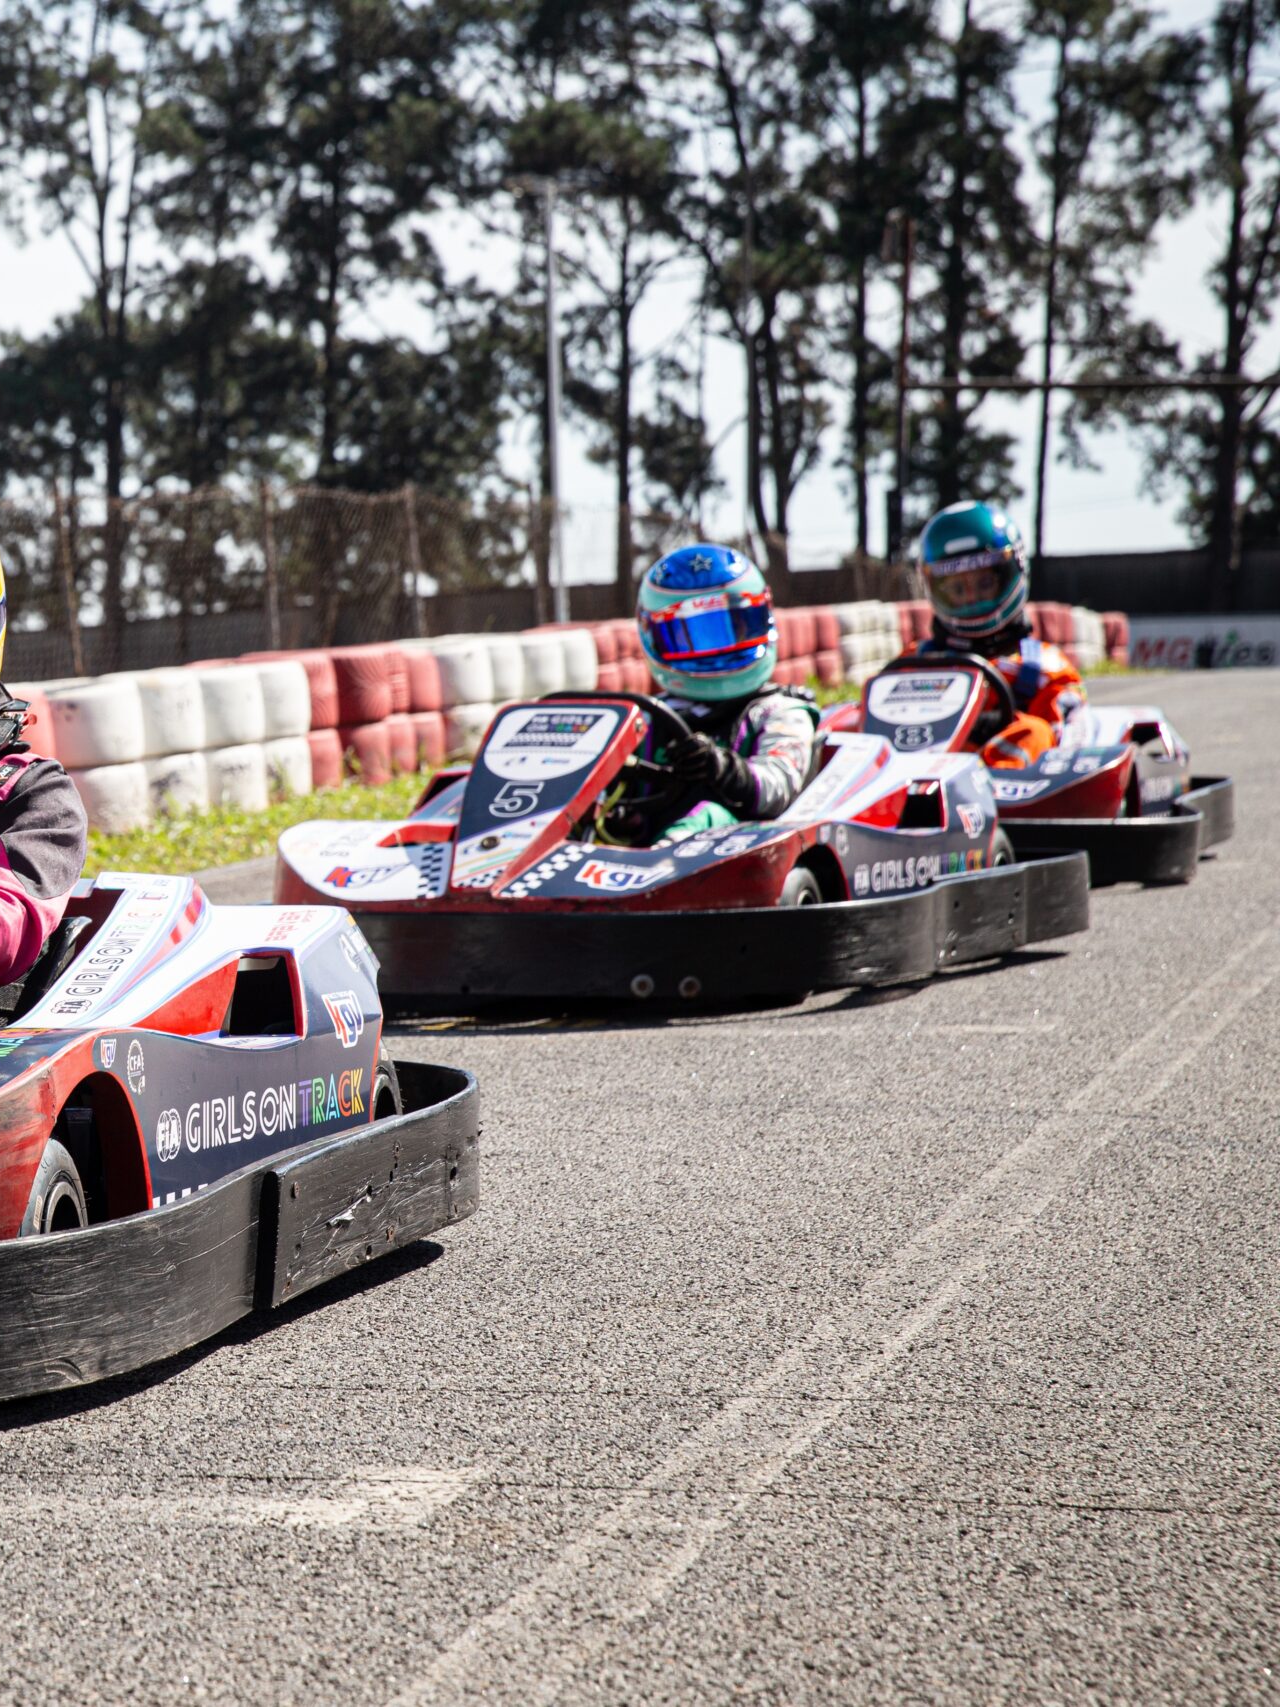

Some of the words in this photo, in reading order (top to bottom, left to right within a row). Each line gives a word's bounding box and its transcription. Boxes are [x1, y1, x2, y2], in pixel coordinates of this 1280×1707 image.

[488, 780, 545, 818] 5
[870, 857, 917, 892] GIRLS
[157, 1112, 181, 1158] FIA
[185, 1090, 257, 1153] GIRLS
[258, 1081, 297, 1137] ON
[297, 1067, 366, 1127] TRACK
